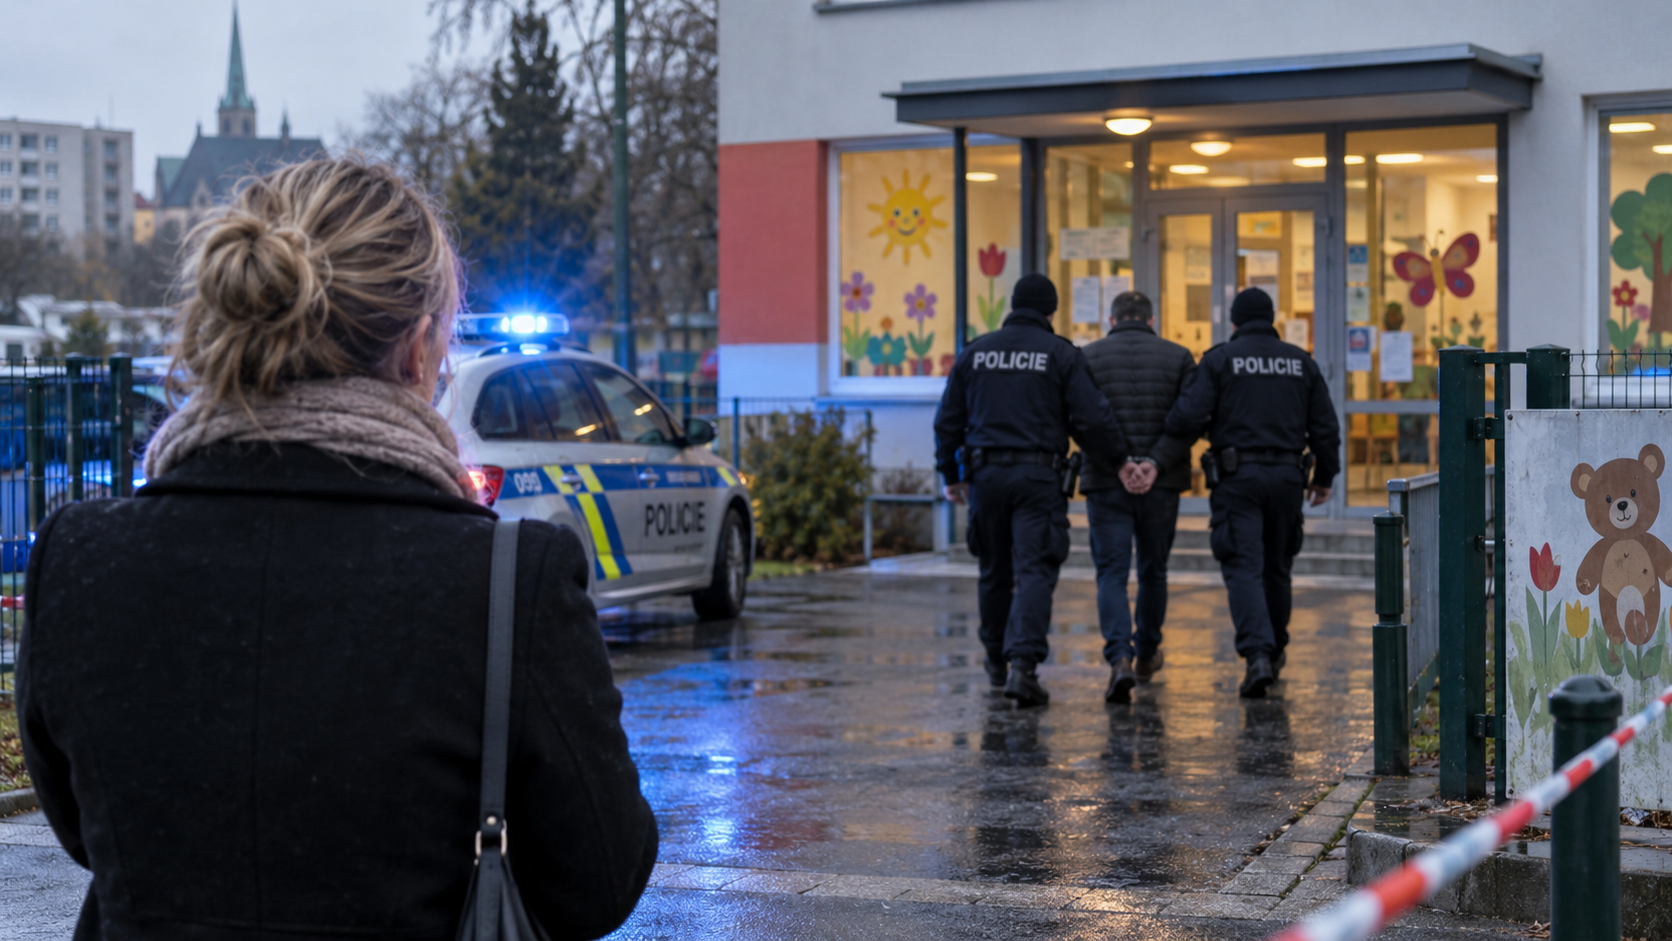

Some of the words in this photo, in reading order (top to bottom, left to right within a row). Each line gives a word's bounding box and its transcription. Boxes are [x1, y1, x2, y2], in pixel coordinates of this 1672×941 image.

[972, 350, 1048, 371] POLICIE
[1232, 356, 1303, 376] POLICIE
[644, 501, 705, 538] POLICIE
